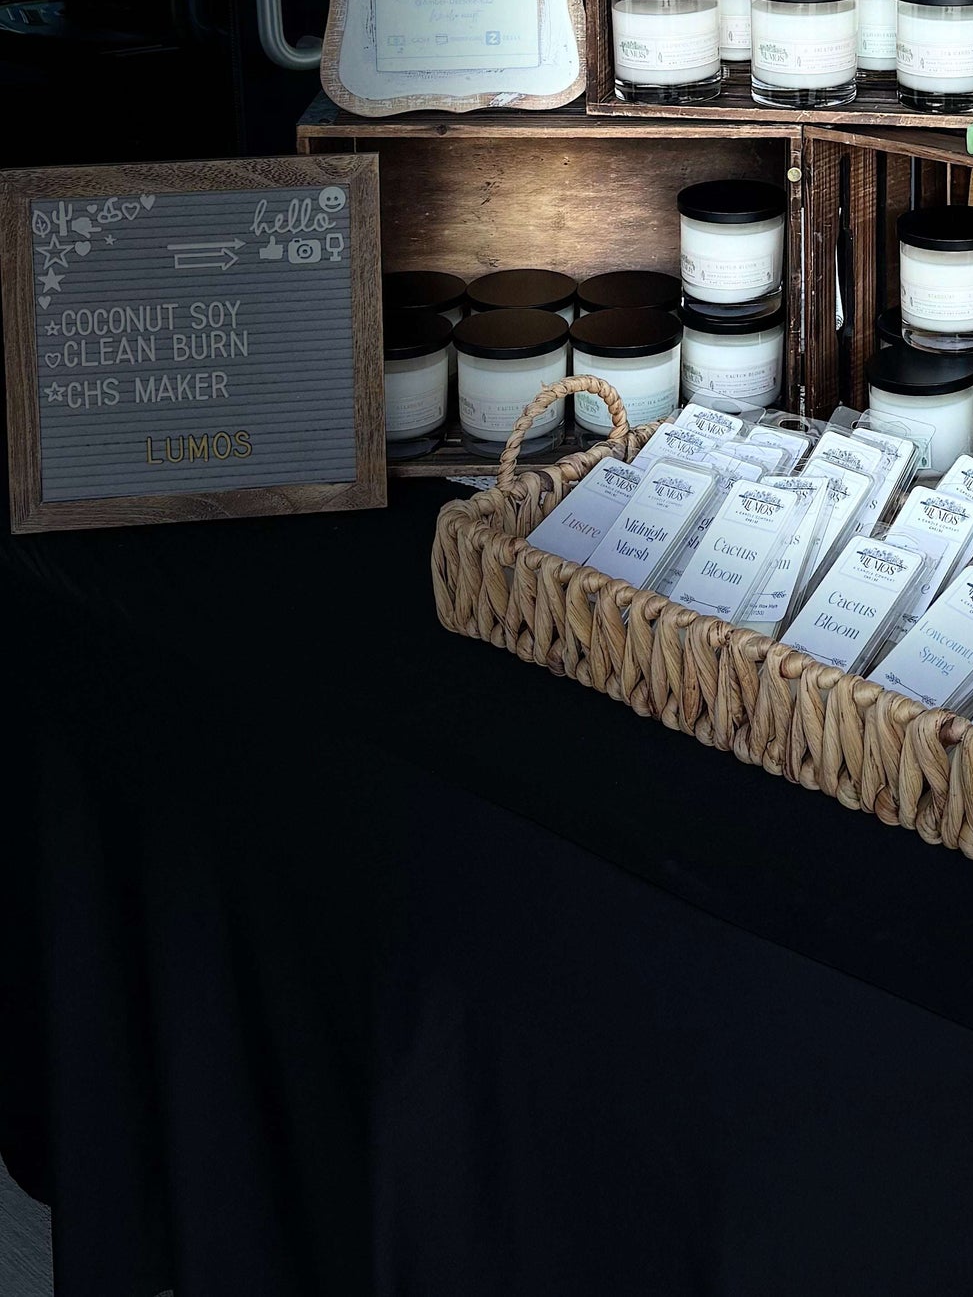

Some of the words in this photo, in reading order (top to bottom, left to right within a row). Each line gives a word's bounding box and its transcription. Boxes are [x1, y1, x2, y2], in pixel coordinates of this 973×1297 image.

[250, 198, 337, 236] hello
[60, 302, 179, 337] COCONUT
[189, 300, 241, 331] SOY
[63, 334, 156, 368] CLEAN
[172, 330, 250, 362] BURN
[66, 377, 120, 409] CHS
[134, 370, 230, 403] MAKER
[146, 430, 253, 464] LUMOS
[744, 499, 776, 517] LUMOS
[927, 507, 961, 526] LUMOS
[561, 512, 602, 539] Lustre
[620, 517, 669, 542] Midnight
[611, 539, 650, 562] Marsh
[713, 536, 758, 562] Cactus
[700, 560, 743, 586] Bloom
[863, 555, 897, 576] LUMOS
[828, 590, 877, 618] Cactus
[814, 612, 860, 640] Bloom
[919, 646, 955, 676] Spring
